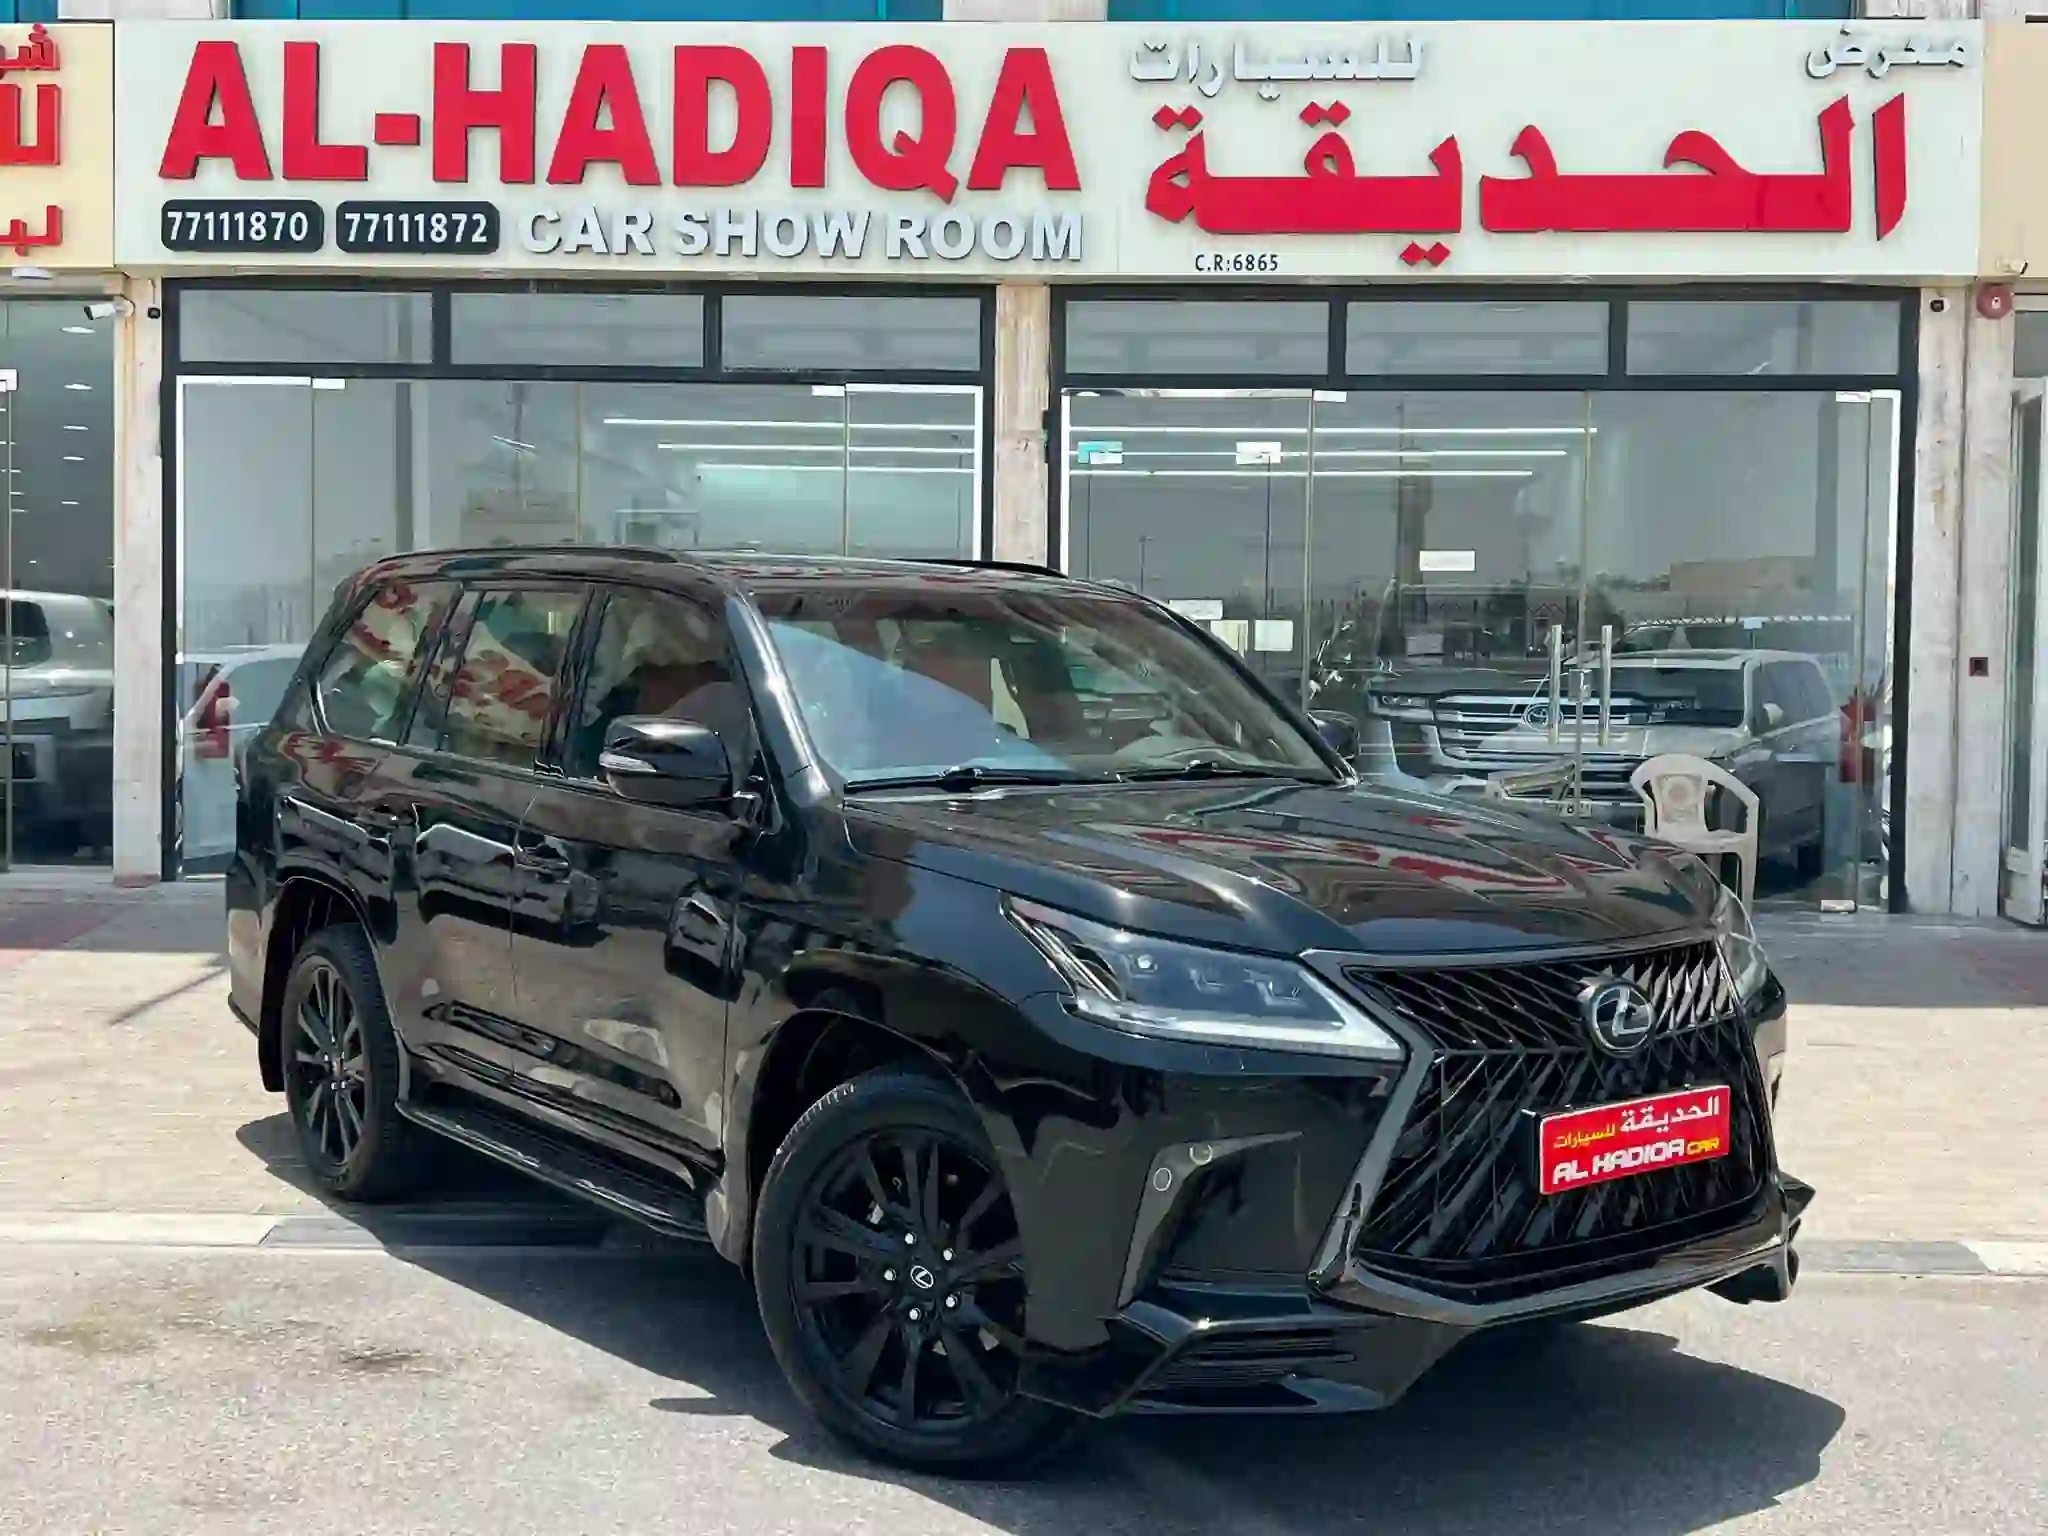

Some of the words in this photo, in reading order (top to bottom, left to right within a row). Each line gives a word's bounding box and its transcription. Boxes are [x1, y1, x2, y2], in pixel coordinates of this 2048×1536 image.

[1129, 37, 1424, 100] للسيارات
[1805, 24, 1966, 79] معرض
[159, 40, 1082, 204] AL-HADIQA
[1145, 92, 1908, 267] الحديقة
[167, 211, 309, 242] 77111870
[344, 213, 488, 243] 77111872
[518, 205, 656, 257] CAR
[674, 208, 871, 260] SHOW
[886, 211, 1083, 262] ROOM
[1194, 253, 1280, 273] C.R:6865
[1553, 1123, 1616, 1149] للسيارات
[1620, 1095, 1720, 1133] الحديقة
[1553, 1159, 1589, 1185] AL
[1686, 1136, 1720, 1156] CAR
